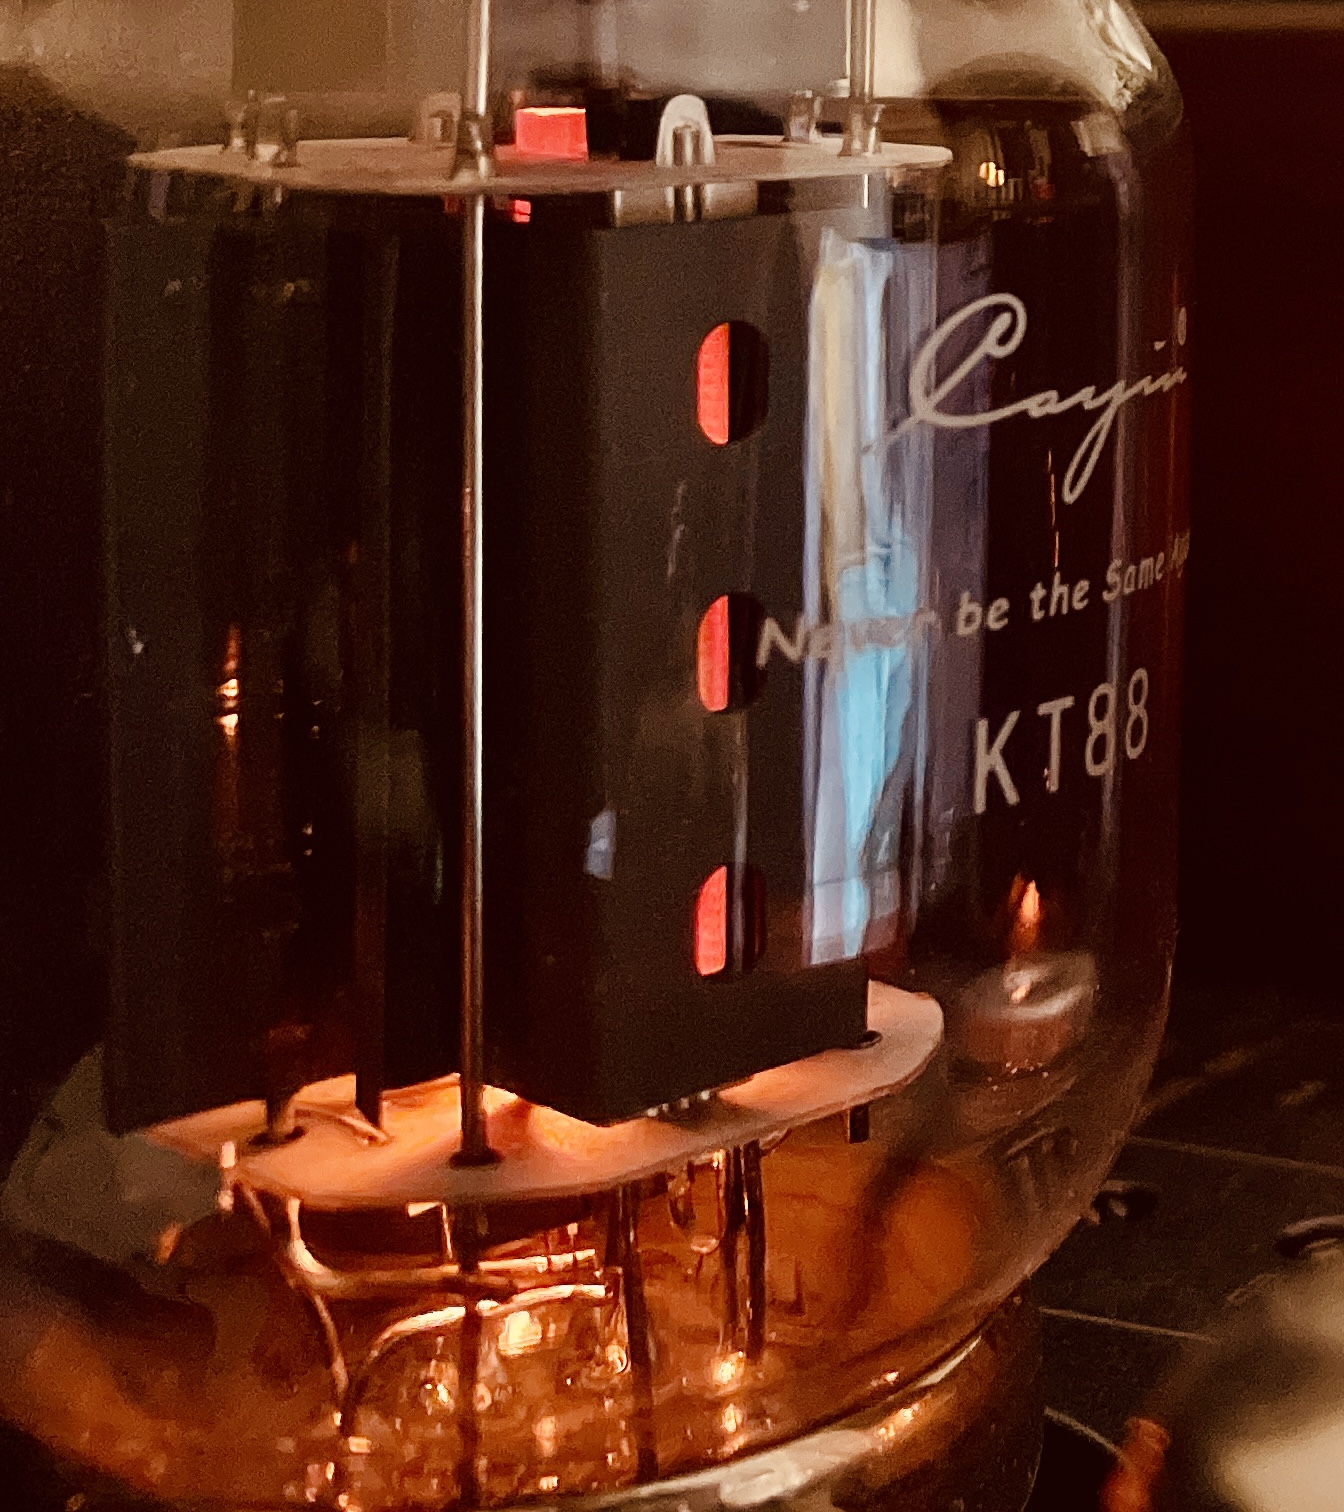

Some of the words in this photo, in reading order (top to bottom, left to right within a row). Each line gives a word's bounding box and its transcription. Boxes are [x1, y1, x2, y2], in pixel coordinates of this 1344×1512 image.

[755, 607, 940, 669] Ner
[956, 590, 1010, 637] be
[1030, 570, 1091, 623] the
[1102, 551, 1166, 602] Same
[972, 667, 1150, 815] KT88
